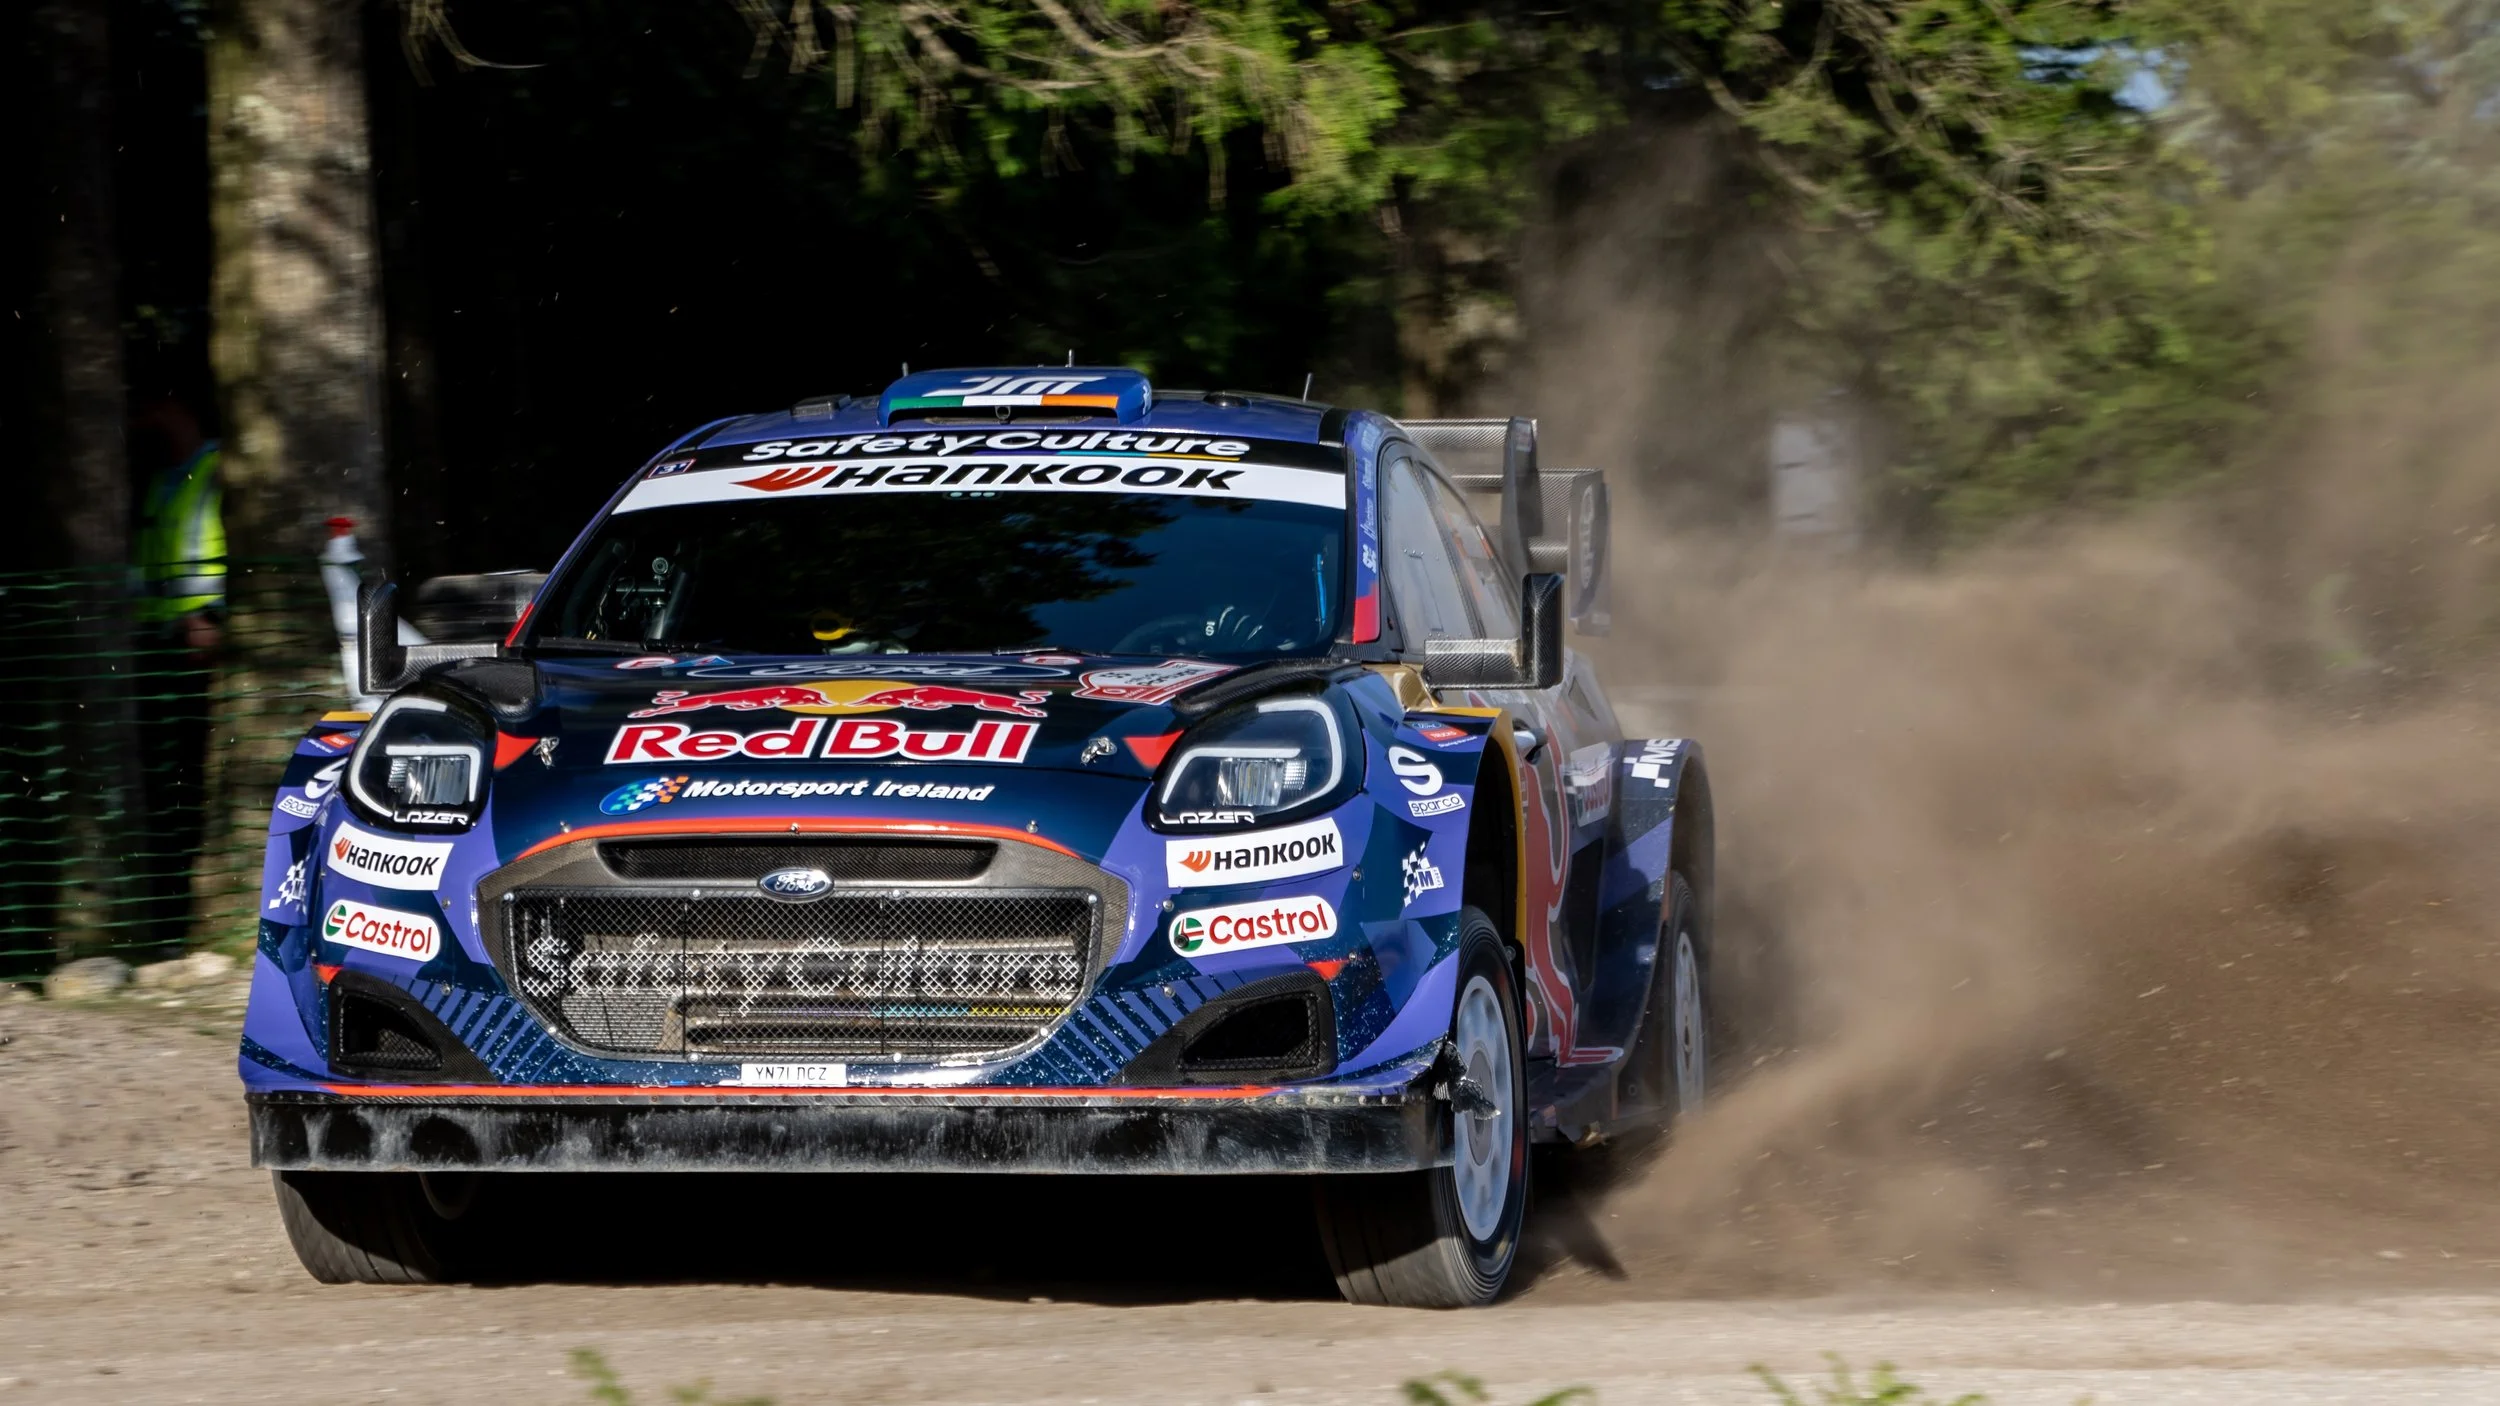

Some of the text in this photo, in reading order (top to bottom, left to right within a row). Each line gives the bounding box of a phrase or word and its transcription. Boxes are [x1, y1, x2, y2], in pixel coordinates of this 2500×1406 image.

[604, 719, 1040, 764] Red Bull
[682, 779, 994, 801] Motorsport Ireland
[1411, 796, 1460, 816] sparco
[394, 811, 468, 825] LAZER
[1160, 812, 1255, 824] LAZER
[775, 873, 816, 892] Ford
[346, 912, 431, 954] Castrol
[1209, 904, 1328, 945] Castrol
